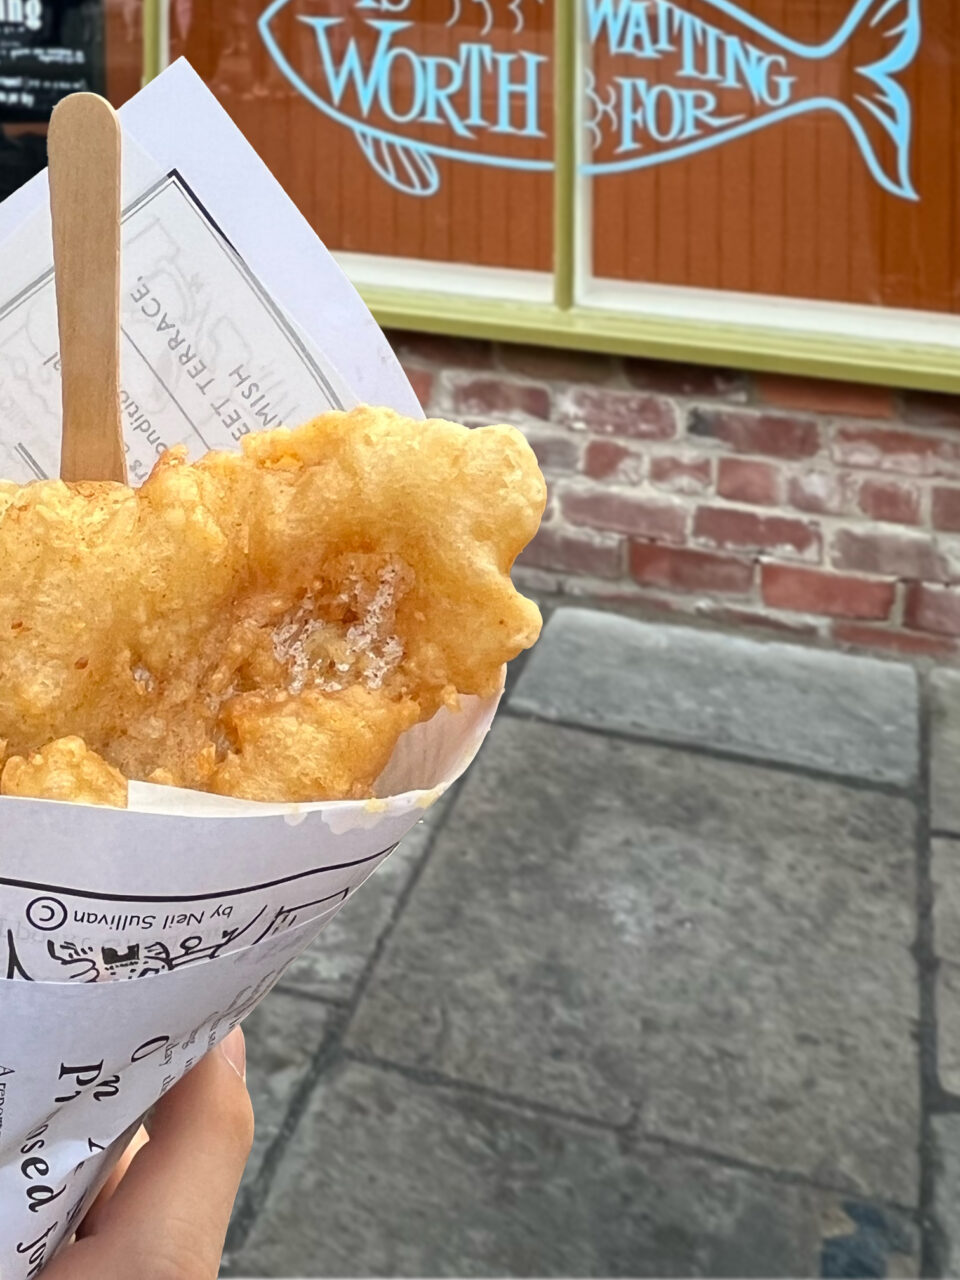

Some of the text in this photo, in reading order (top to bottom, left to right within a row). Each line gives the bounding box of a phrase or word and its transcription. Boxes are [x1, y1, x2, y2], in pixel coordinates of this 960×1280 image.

[296, 15, 548, 139] WORTH
[614, 77, 746, 153] FOR
[229, 364, 283, 428] MISH
[210, 398, 251, 442] EET
[73, 910, 156, 931] Sullivan
[162, 910, 206, 931] Neil
[210, 904, 234, 921] by
